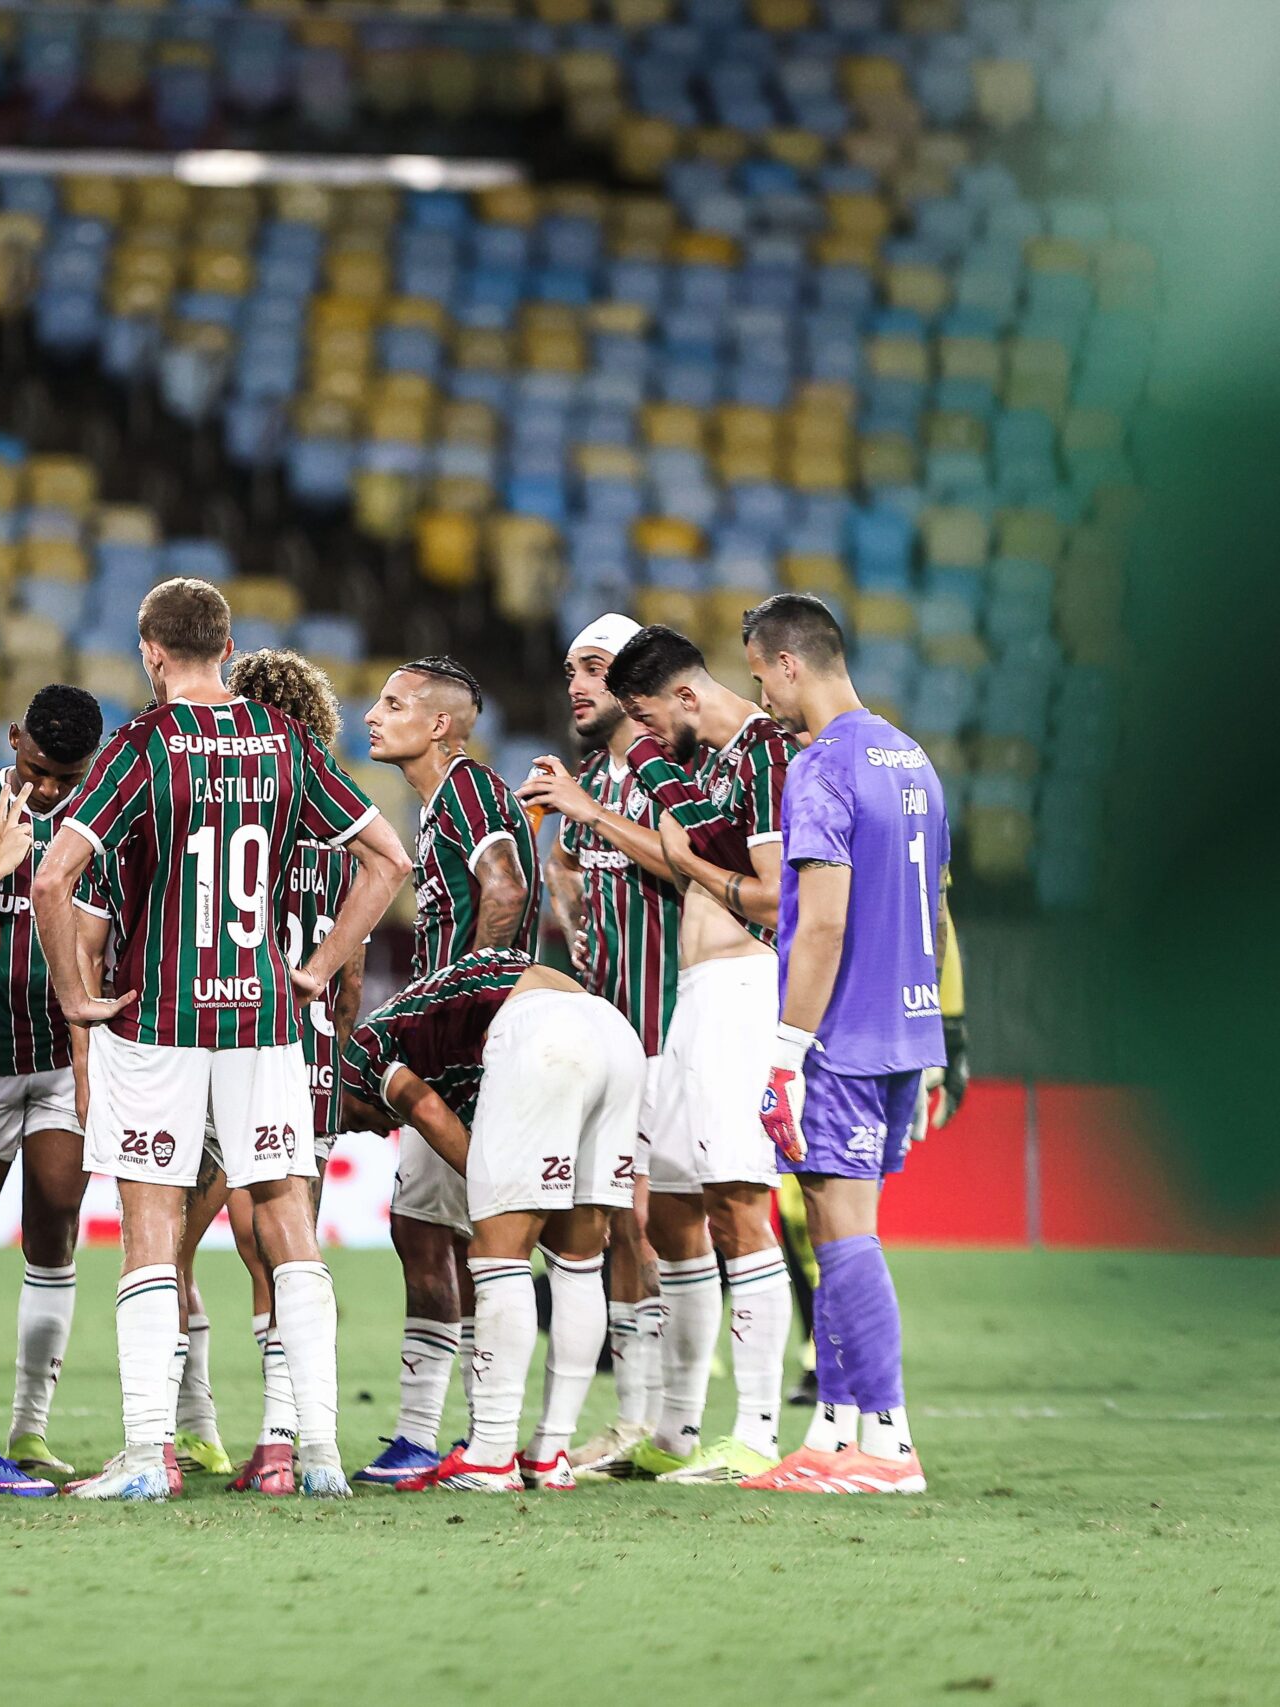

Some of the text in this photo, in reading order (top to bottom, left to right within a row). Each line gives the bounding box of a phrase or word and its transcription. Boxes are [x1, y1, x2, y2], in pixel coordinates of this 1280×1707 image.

[168, 734, 287, 756] SUPERBET
[195, 777, 275, 803] CASTILLO
[187, 824, 269, 949] 19
[908, 831, 934, 956] 1
[193, 977, 262, 1001] UNIG
[238, 1001, 262, 1009] IGUAÇU
[120, 1129, 150, 1156] Zé
[254, 1125, 281, 1152] Zé
[118, 1154, 148, 1165] DELIVERY
[541, 1156, 572, 1182] Zé
